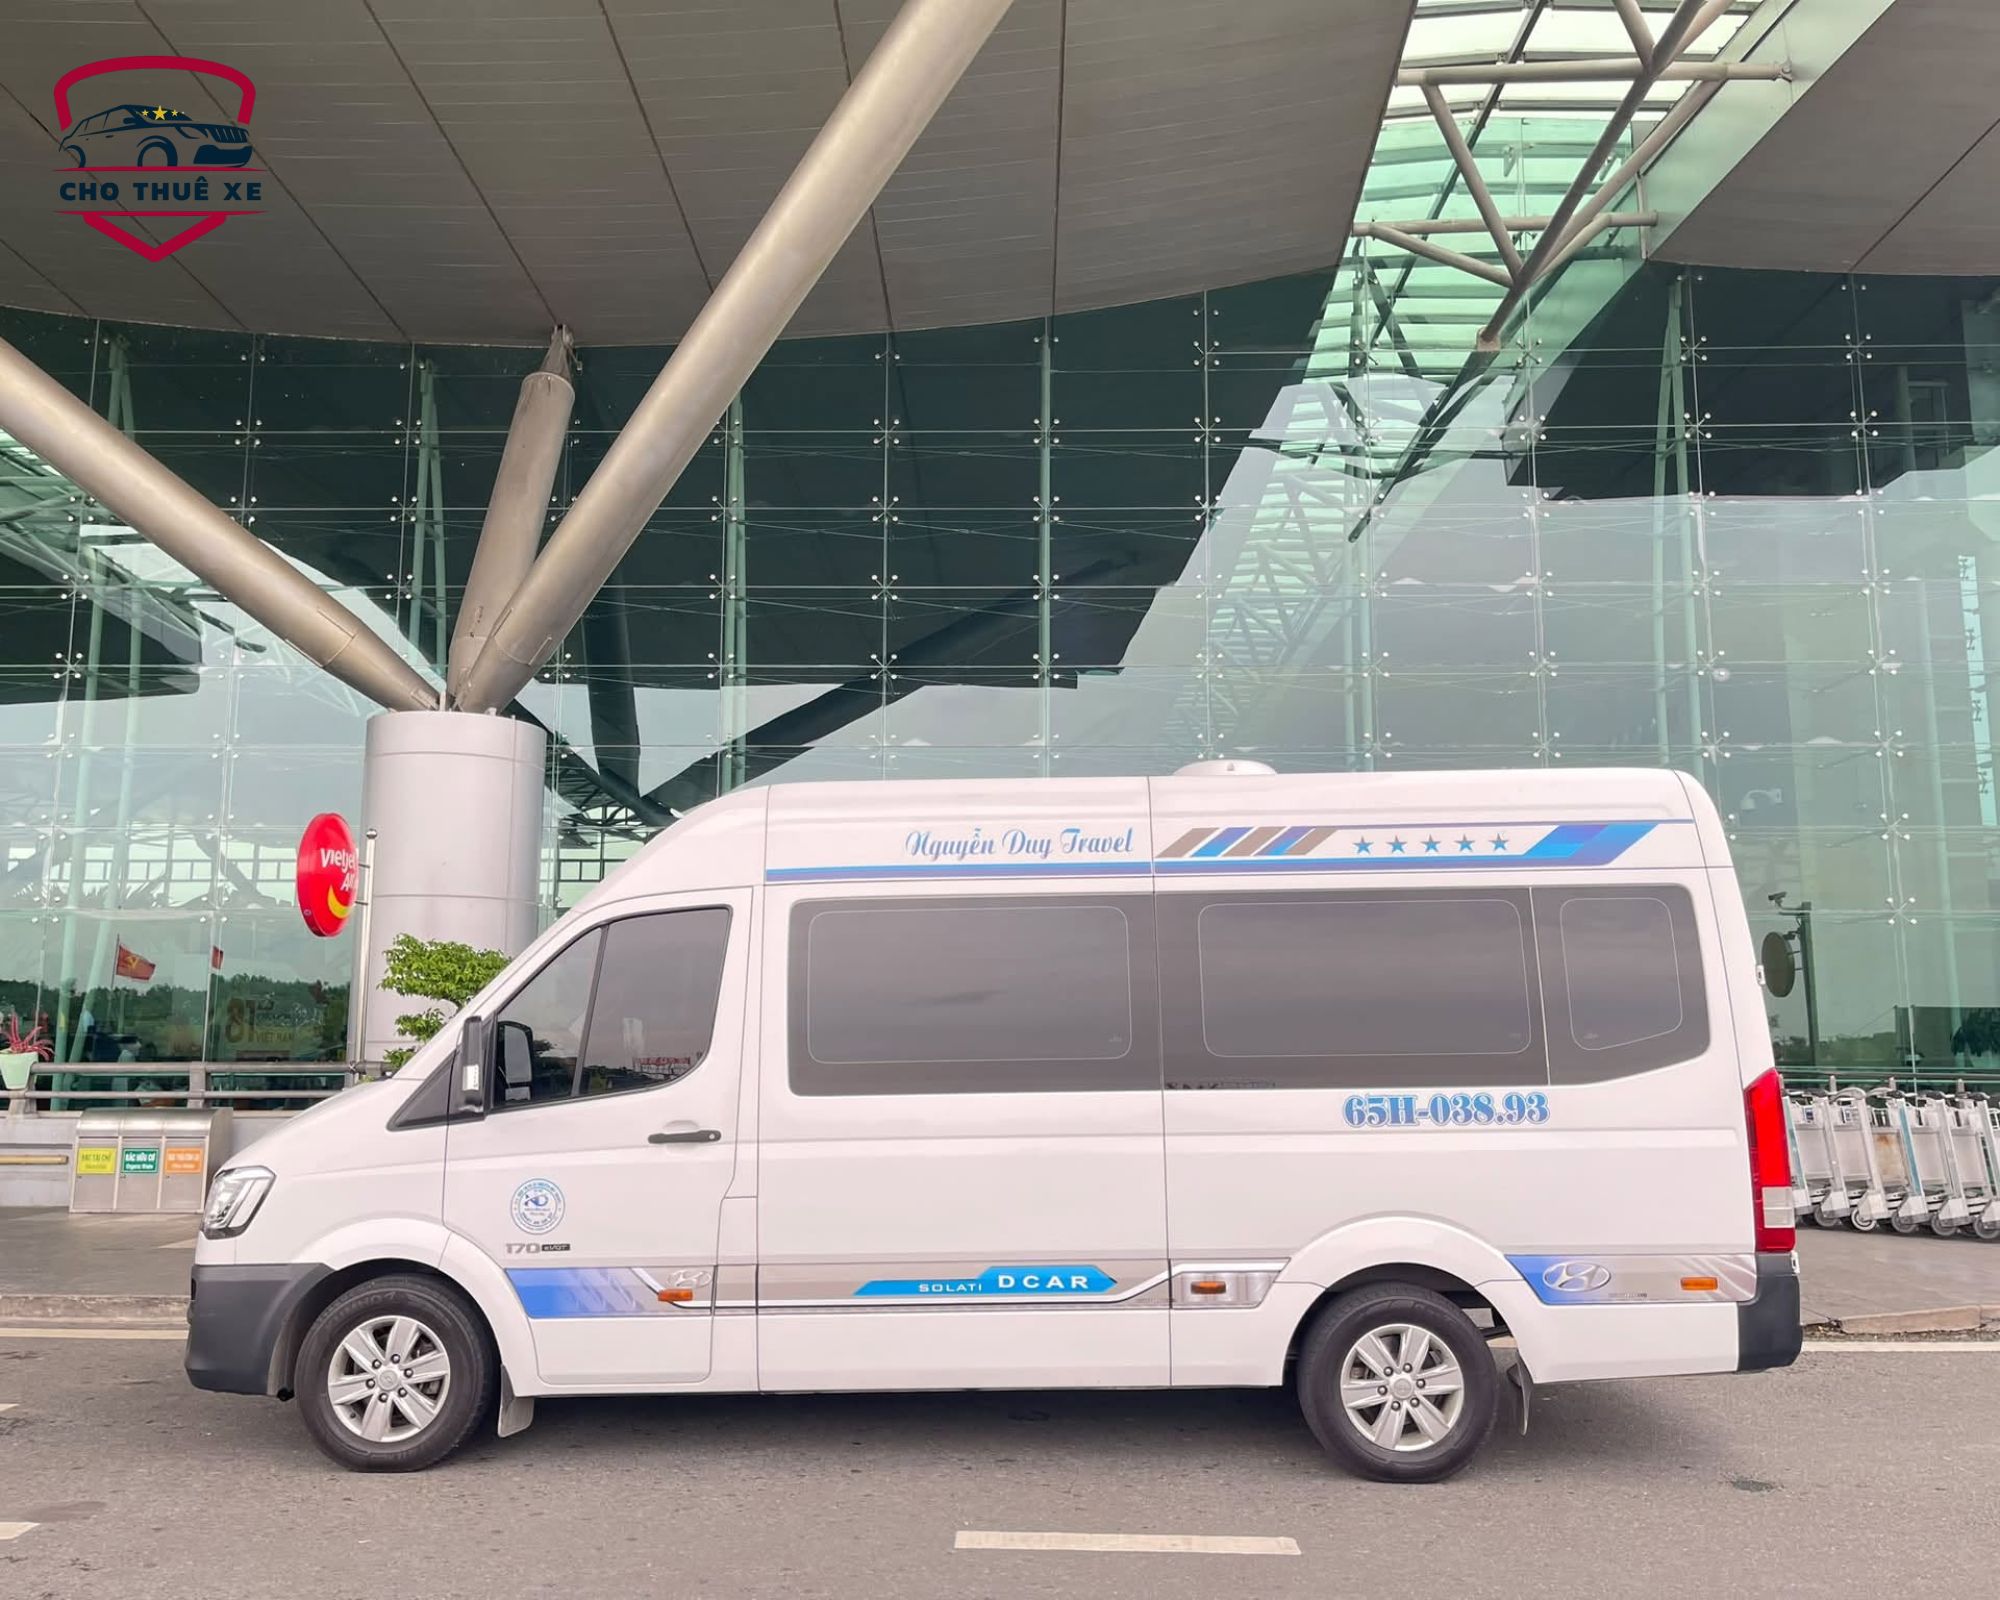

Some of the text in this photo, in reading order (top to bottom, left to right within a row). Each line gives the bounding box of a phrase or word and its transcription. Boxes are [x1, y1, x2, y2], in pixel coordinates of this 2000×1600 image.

[1001, 829, 1052, 860] Duy
[1059, 827, 1135, 854] Travel
[1343, 1092, 1550, 1127] 65H-038.93
[918, 1275, 1089, 1293] SOLATI DCAR
